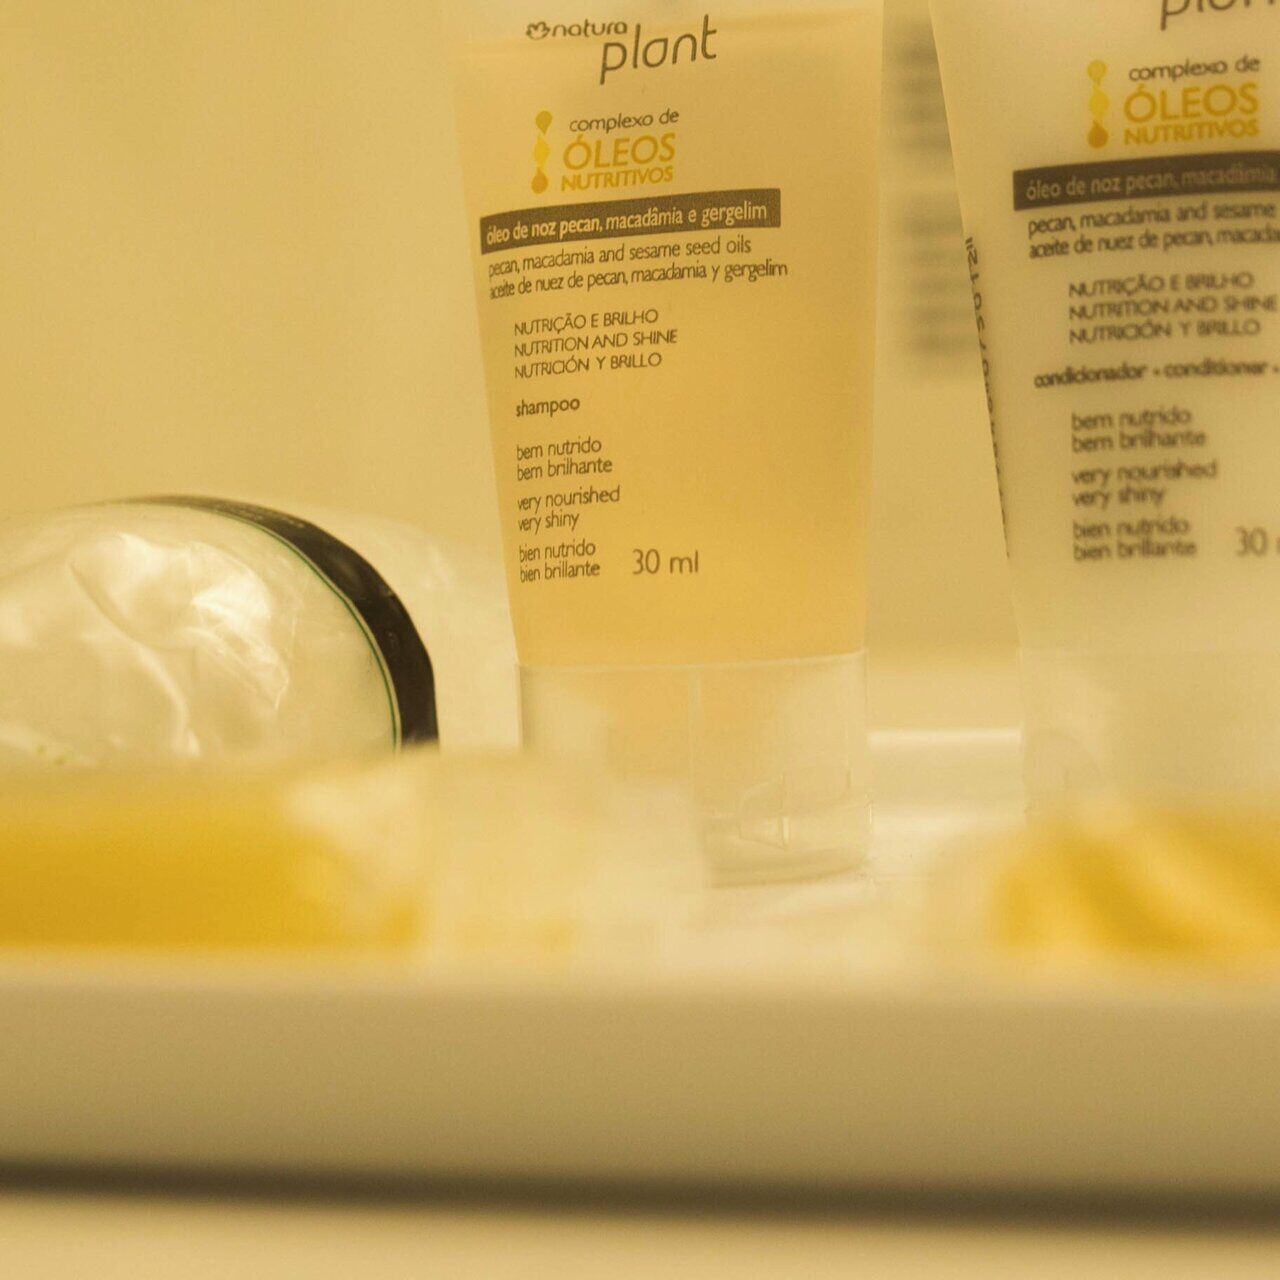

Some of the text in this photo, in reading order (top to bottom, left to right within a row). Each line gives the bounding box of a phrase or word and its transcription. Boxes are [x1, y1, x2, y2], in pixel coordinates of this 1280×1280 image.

[551, 19, 628, 37] natura
[600, 15, 717, 84] plant
[1128, 54, 1260, 83] complexo de
[1124, 81, 1260, 122] ÓLEOS
[569, 108, 679, 134] complexo de
[1124, 118, 1260, 145] NUTRITIVOS
[563, 133, 676, 171] ÓLEOS
[561, 167, 674, 192] NUTRITIVOS
[1026, 178, 1061, 200] óleo
[1066, 175, 1085, 196] de
[1091, 176, 1121, 194] noz
[1125, 171, 1180, 194] pecan,
[1181, 162, 1278, 185] macadâmia
[487, 201, 767, 245] óleo de noz pecan, macadâmia e gergelim
[1028, 216, 1076, 239] pecan,
[1080, 206, 1171, 228] macadamia
[1177, 202, 1207, 221] and
[1213, 204, 1277, 220] sesame
[489, 235, 751, 279] pecan, macadamia and sesame seed oils
[1029, 237, 1069, 259] aceite
[1074, 235, 1093, 253] de
[1097, 235, 1134, 251] nuez
[1138, 230, 1158, 248] de
[1163, 229, 1214, 249] pecan,
[490, 258, 788, 299] aceite de nuez de pecan, macadamia y gergelim
[1069, 272, 1254, 298] NUTRIÇÃO E BRILHO
[1069, 294, 1278, 321] NUTRITION AND SHINE
[514, 309, 659, 336] NUTRIÇÃO E BRILHO
[1069, 318, 1261, 345] NUTRICIÓN Y BRILLO
[514, 328, 678, 357] NUTRITION AND SHINE
[514, 352, 662, 379] NUTRICIÓN Y BRILLO
[1034, 364, 1147, 389] condicionador
[1162, 358, 1268, 379] conditioner
[516, 398, 580, 418] shampoo
[1071, 406, 1191, 431] bem nutrido
[517, 436, 602, 460] bem nutrido
[1072, 428, 1206, 453] bem brilhante
[517, 458, 613, 481] bem brilhante
[1072, 459, 1217, 487] very nourished
[518, 485, 621, 513] very nourished
[1072, 484, 1164, 509] very shiny
[518, 510, 580, 535] very shiny
[1073, 515, 1189, 539] bien nutrido
[519, 539, 596, 563] bien nutrido
[1073, 537, 1197, 562] bien brillante
[1236, 527, 1267, 557] 30
[520, 558, 600, 583] bien brillante
[632, 549, 699, 574] 30 ml
